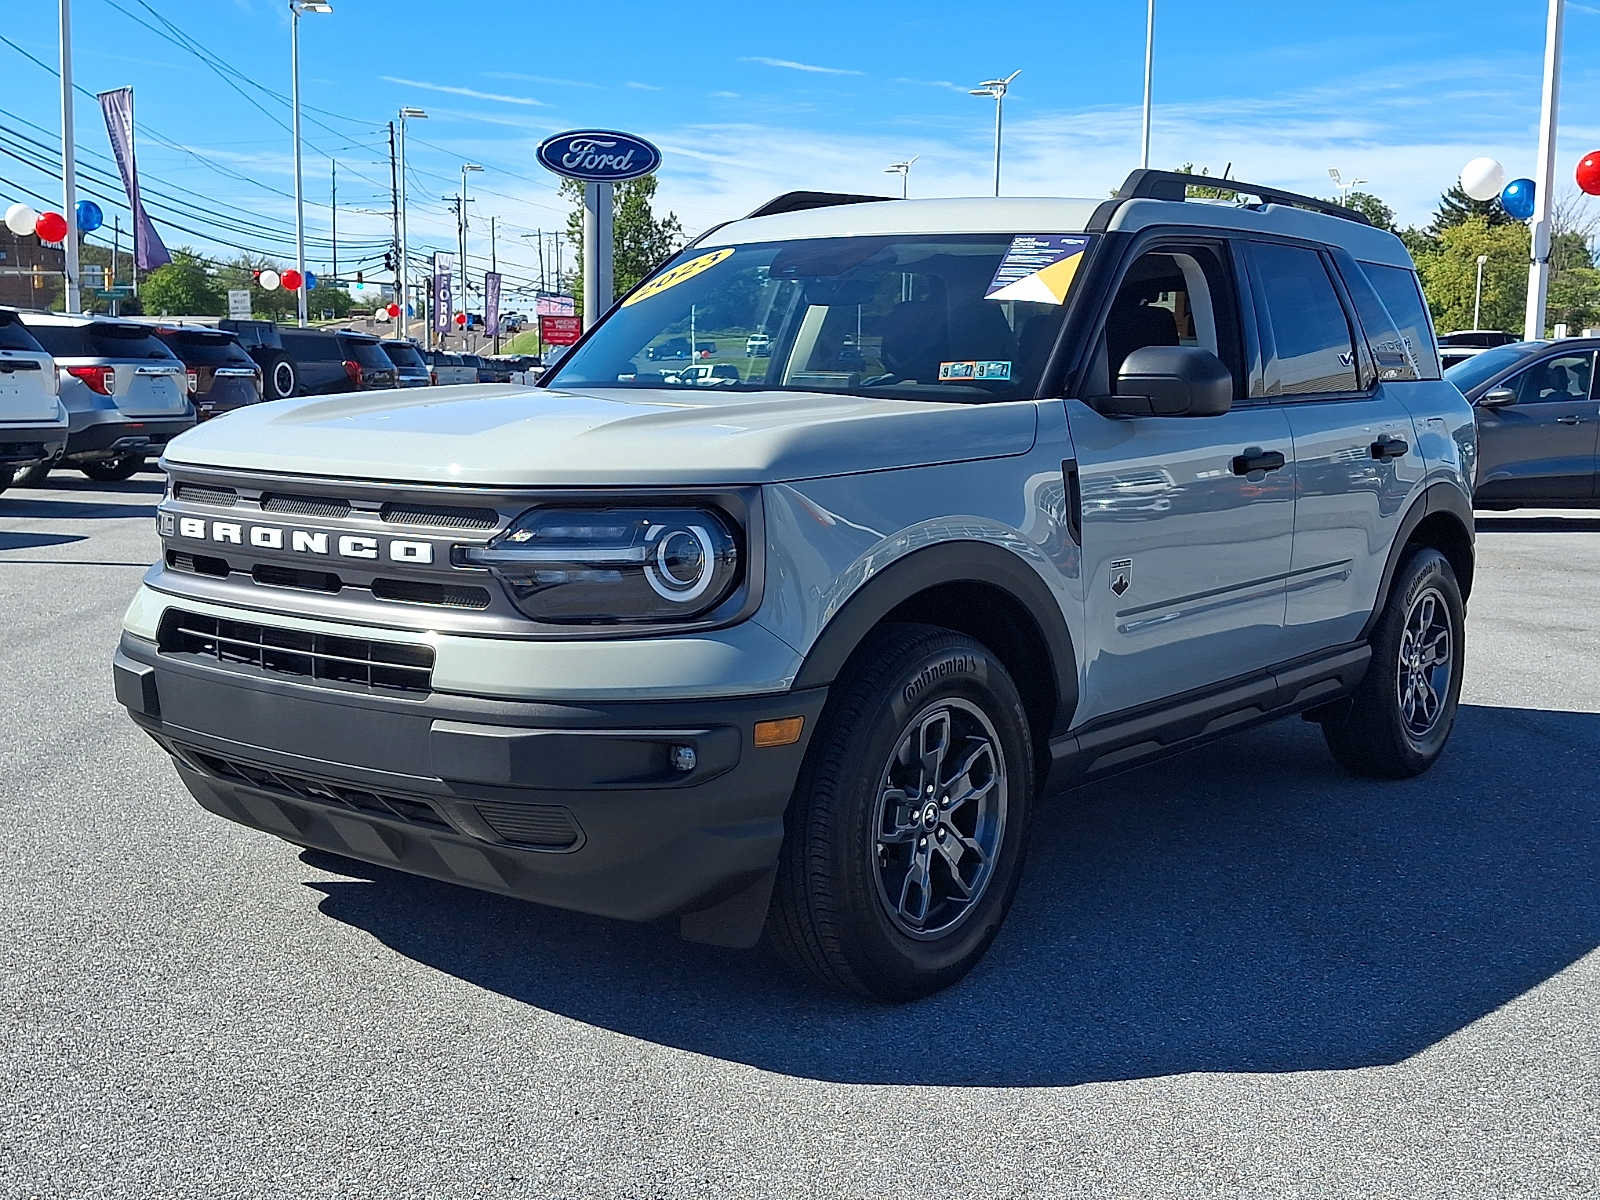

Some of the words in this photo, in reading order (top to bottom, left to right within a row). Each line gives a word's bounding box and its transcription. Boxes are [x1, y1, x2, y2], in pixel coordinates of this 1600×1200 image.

[562, 138, 635, 170] Ford
[632, 251, 723, 301] 2023
[439, 276, 450, 327] FORD
[943, 367, 949, 377] 9
[978, 365, 985, 377] 9
[179, 516, 433, 564] BRONCO
[902, 655, 969, 704] Continental
